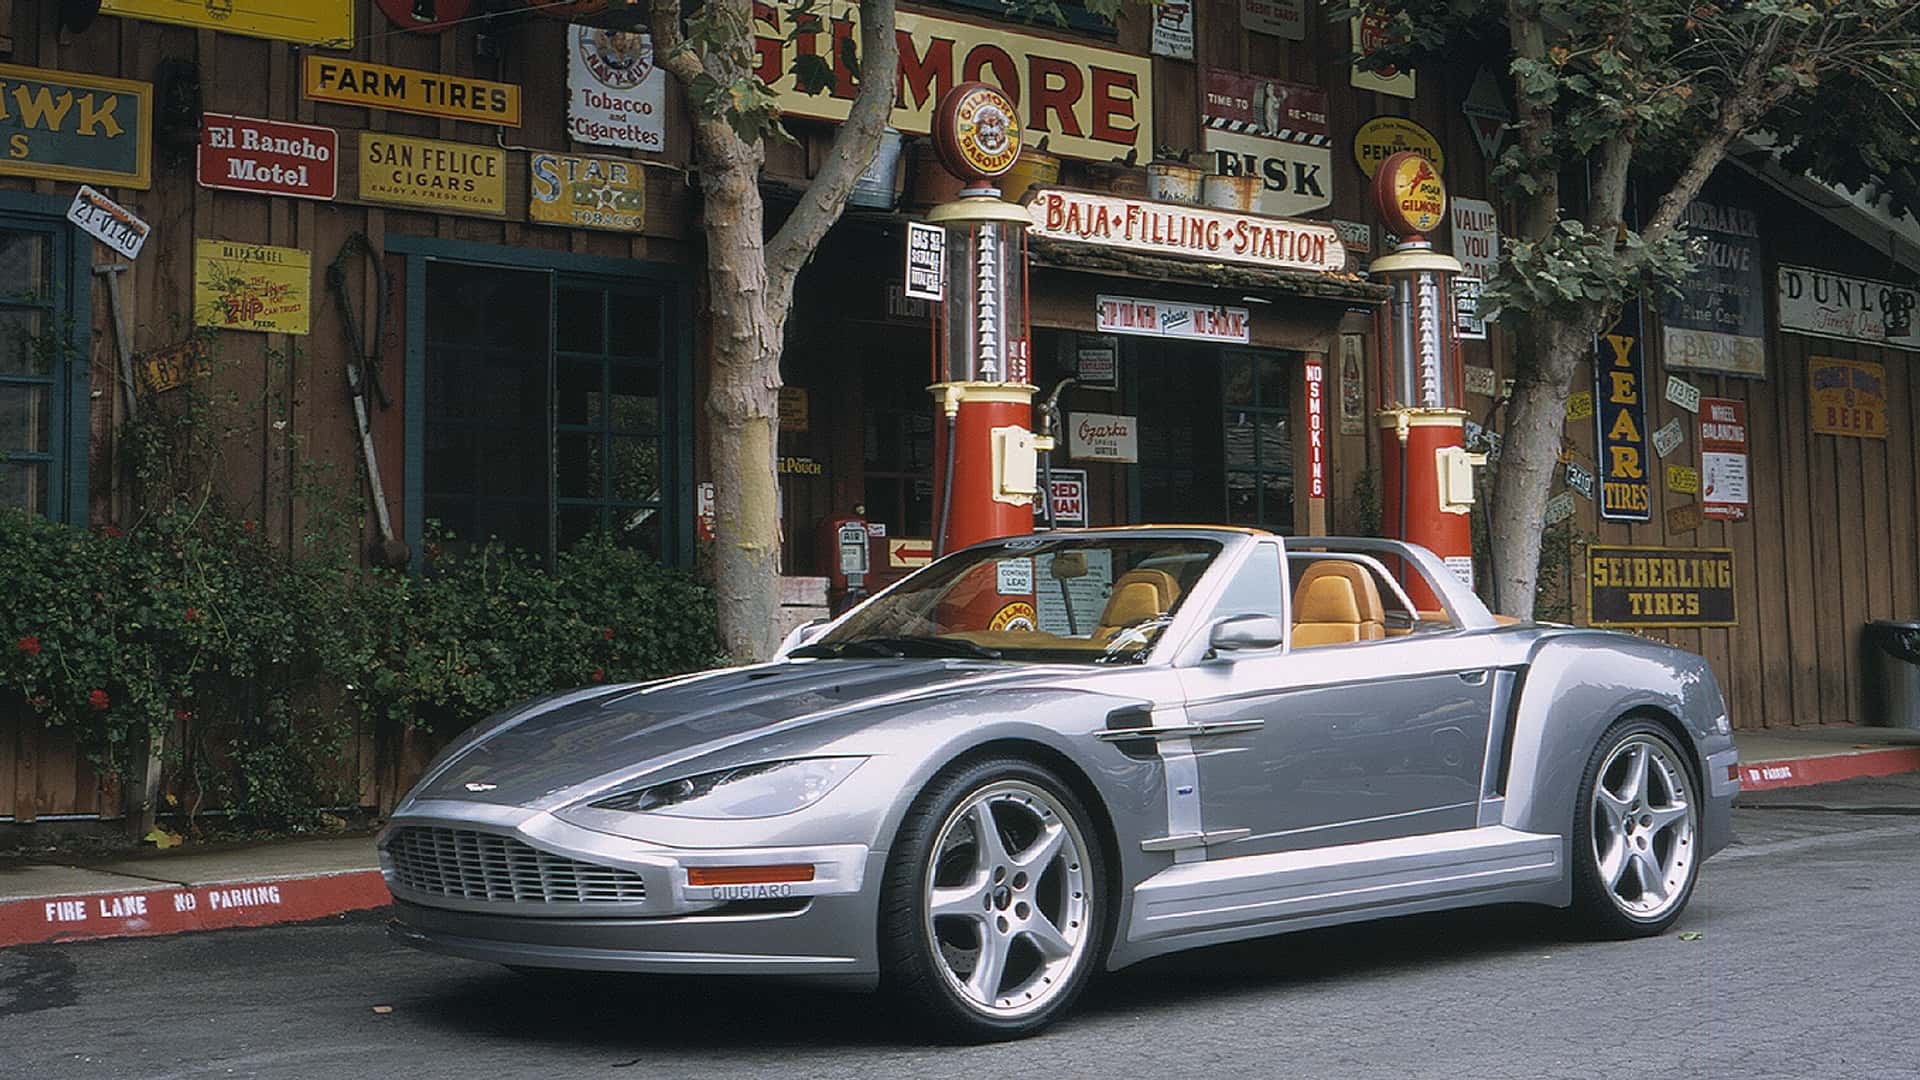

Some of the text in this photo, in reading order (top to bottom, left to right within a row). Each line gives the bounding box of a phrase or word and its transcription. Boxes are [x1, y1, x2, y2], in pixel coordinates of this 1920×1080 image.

[587, 53, 650, 86] NAVY CUT
[319, 64, 506, 113] FARM TIRES
[582, 88, 653, 115] Tobacco
[1208, 93, 1232, 107] TIME
[1235, 99, 1249, 110] TO
[608, 113, 627, 123] and
[208, 126, 330, 162] El Rancho
[575, 119, 659, 146] Cigarettes
[227, 158, 310, 187] Motel
[369, 142, 497, 178] SAN FELICE
[392, 170, 476, 193] CIGARS
[534, 154, 629, 203] STAR
[371, 185, 493, 205] ENJOY A FRESH CIGAR
[1402, 200, 1440, 215] GILMORE
[573, 211, 641, 228] TOBACCO
[1045, 193, 1325, 265] BAJA FILLING STATION
[1455, 207, 1494, 231] VALUE
[1463, 236, 1489, 258] YOU
[1161, 310, 1189, 335] please
[1194, 310, 1205, 333] NO
[1207, 311, 1244, 337] SMOKING
[1079, 420, 1127, 445] Ozarka
[1306, 364, 1323, 496] NO SMOKING
[1828, 406, 1874, 433] BEER
[1604, 482, 1648, 511] TIRES
[1007, 579, 1027, 587] LEAD
[1593, 557, 1731, 588] SEIBERLING
[991, 602, 1036, 631] GILMO
[1628, 592, 1699, 615] TIRES
[45, 886, 281, 922] FIRE LANE NO PARKING
[711, 883, 792, 900] GIUGIARO
